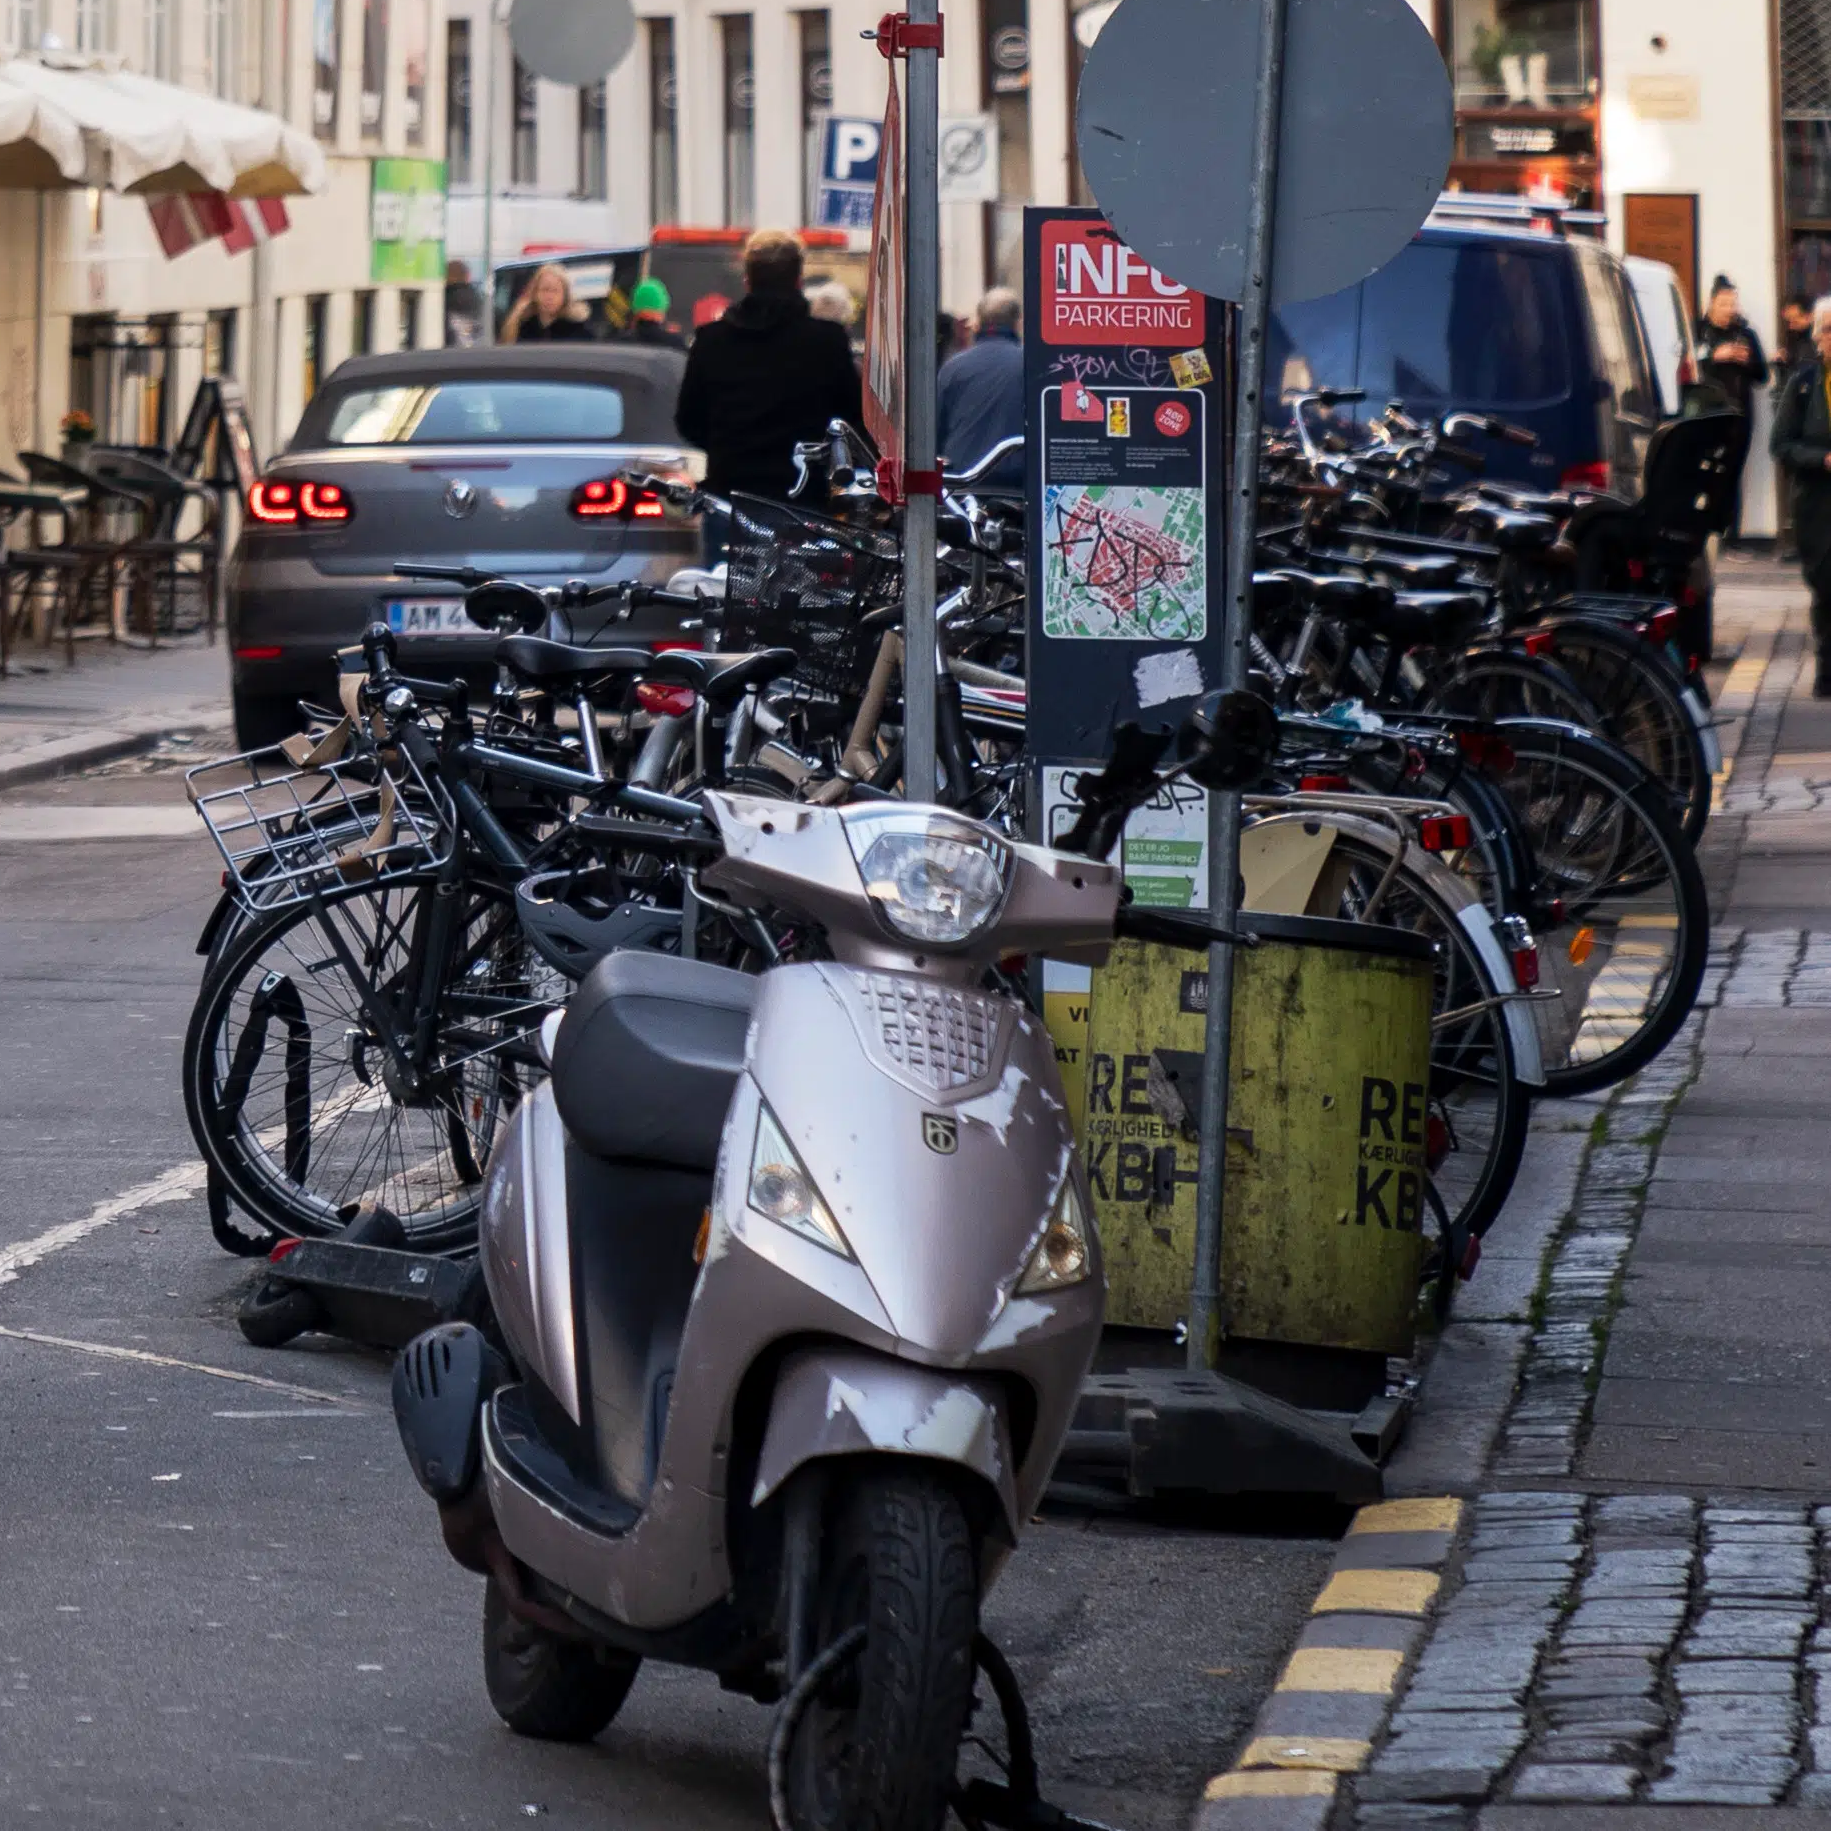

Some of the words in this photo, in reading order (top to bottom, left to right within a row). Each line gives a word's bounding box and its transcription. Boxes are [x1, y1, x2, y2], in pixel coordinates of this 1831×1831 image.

[834, 122, 879, 181] P
[1056, 305, 1191, 328] PARKERING
[1158, 415, 1181, 432] ZONE
[1165, 407, 1184, 422] RØD
[408, 606, 441, 630] AM
[1088, 1053, 1155, 1116] RE
[1360, 1076, 1425, 1145] RE
[1356, 1164, 1424, 1232] KB
